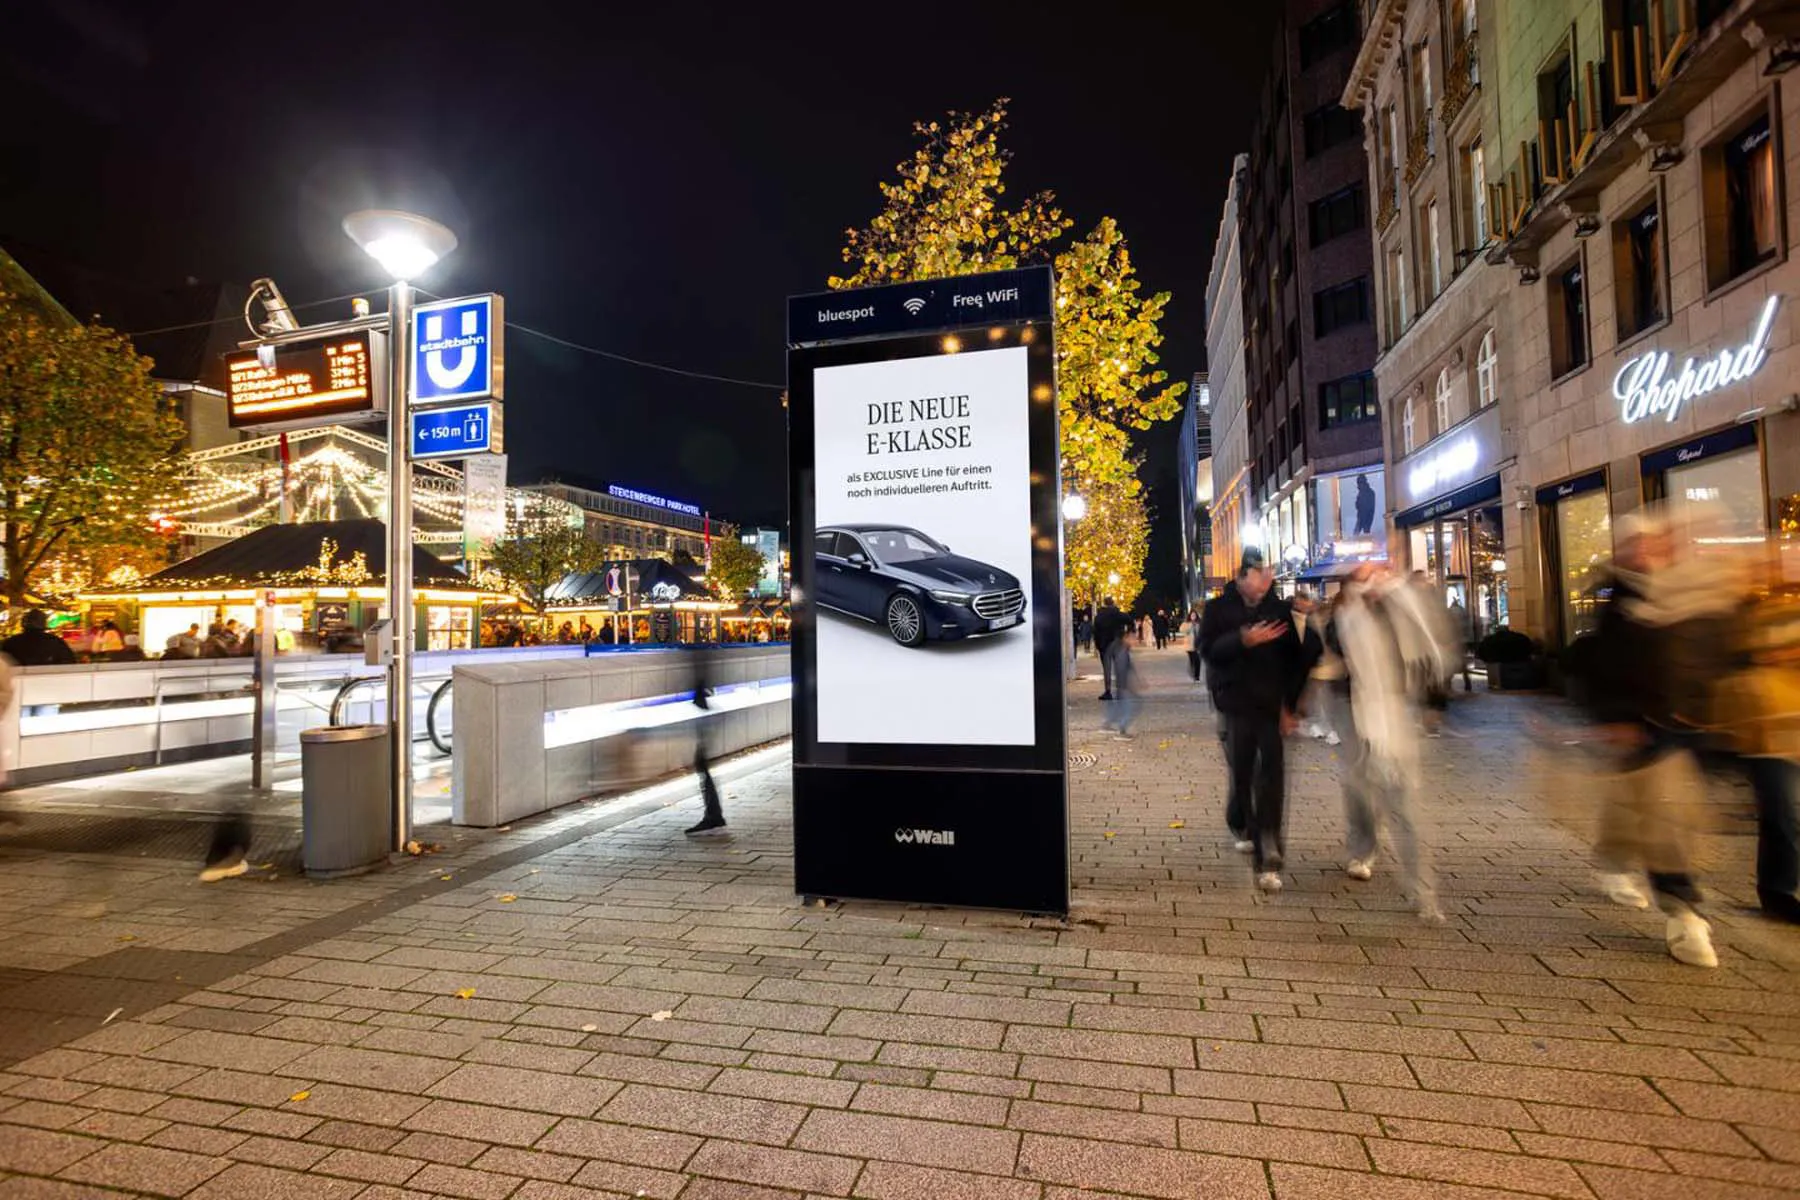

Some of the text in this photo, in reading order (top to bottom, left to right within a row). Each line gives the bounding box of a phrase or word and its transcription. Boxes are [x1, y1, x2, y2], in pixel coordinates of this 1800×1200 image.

[818, 288, 1019, 322] bluespot Free WiFi
[419, 335, 485, 353] stadtbahn
[1613, 294, 1778, 423] Chopard
[867, 395, 970, 425] DIE NEUE
[431, 427, 461, 439] 150 m
[866, 425, 971, 455] E-KLASSE
[847, 464, 992, 483] als EXCLUSIVE Line für einen
[847, 480, 992, 498] noch individuelleren Auftritt.
[914, 829, 955, 845] Wall
